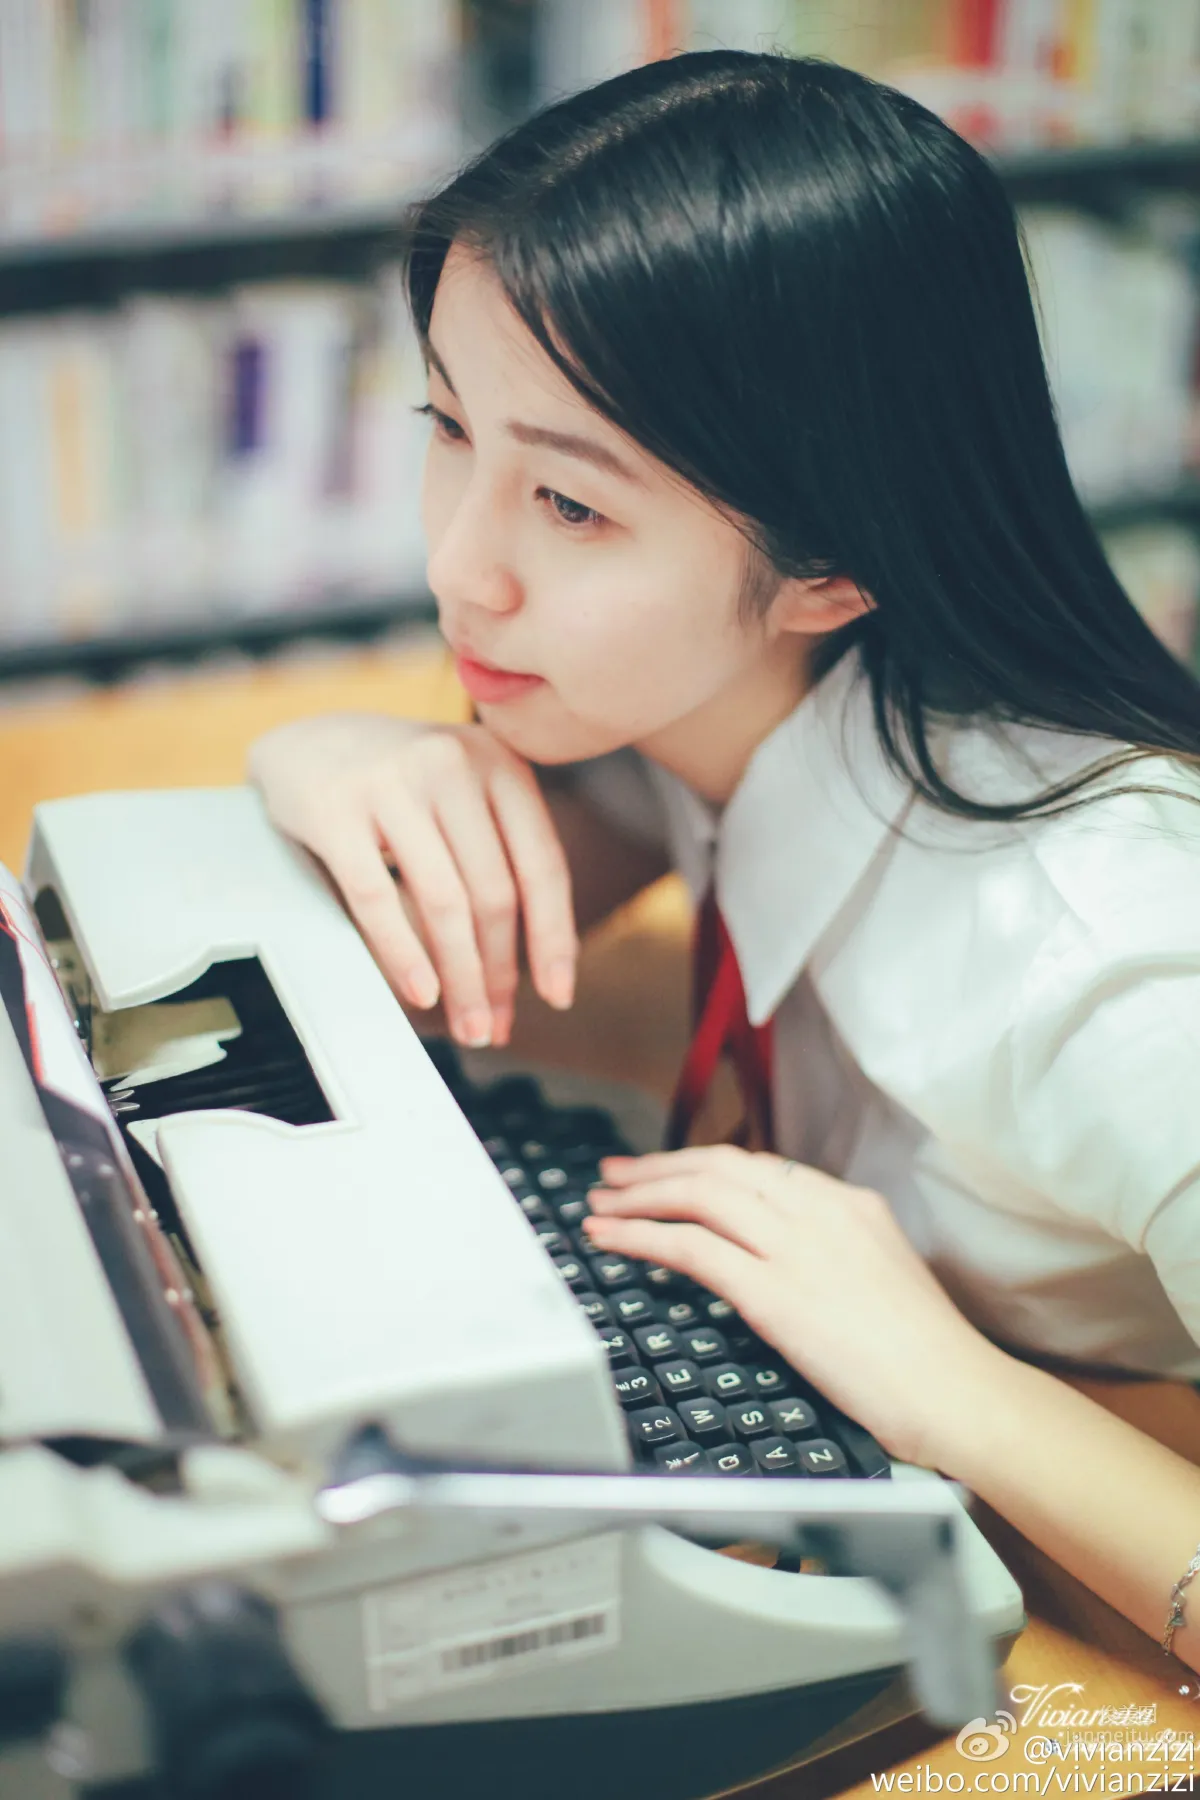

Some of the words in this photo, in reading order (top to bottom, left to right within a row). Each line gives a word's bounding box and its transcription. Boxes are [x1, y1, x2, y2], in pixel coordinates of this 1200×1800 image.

[619, 1301, 644, 1316] T
[646, 1332, 673, 1350] R
[690, 1338, 718, 1353] F
[666, 1368, 692, 1385] E
[717, 1372, 742, 1389] D
[755, 1370, 779, 1386] C
[690, 1409, 715, 1425] W
[741, 1410, 764, 1426] S
[779, 1407, 804, 1423] X
[765, 1446, 788, 1460] A
[808, 1448, 833, 1464] Z
[718, 1454, 740, 1470] Q
